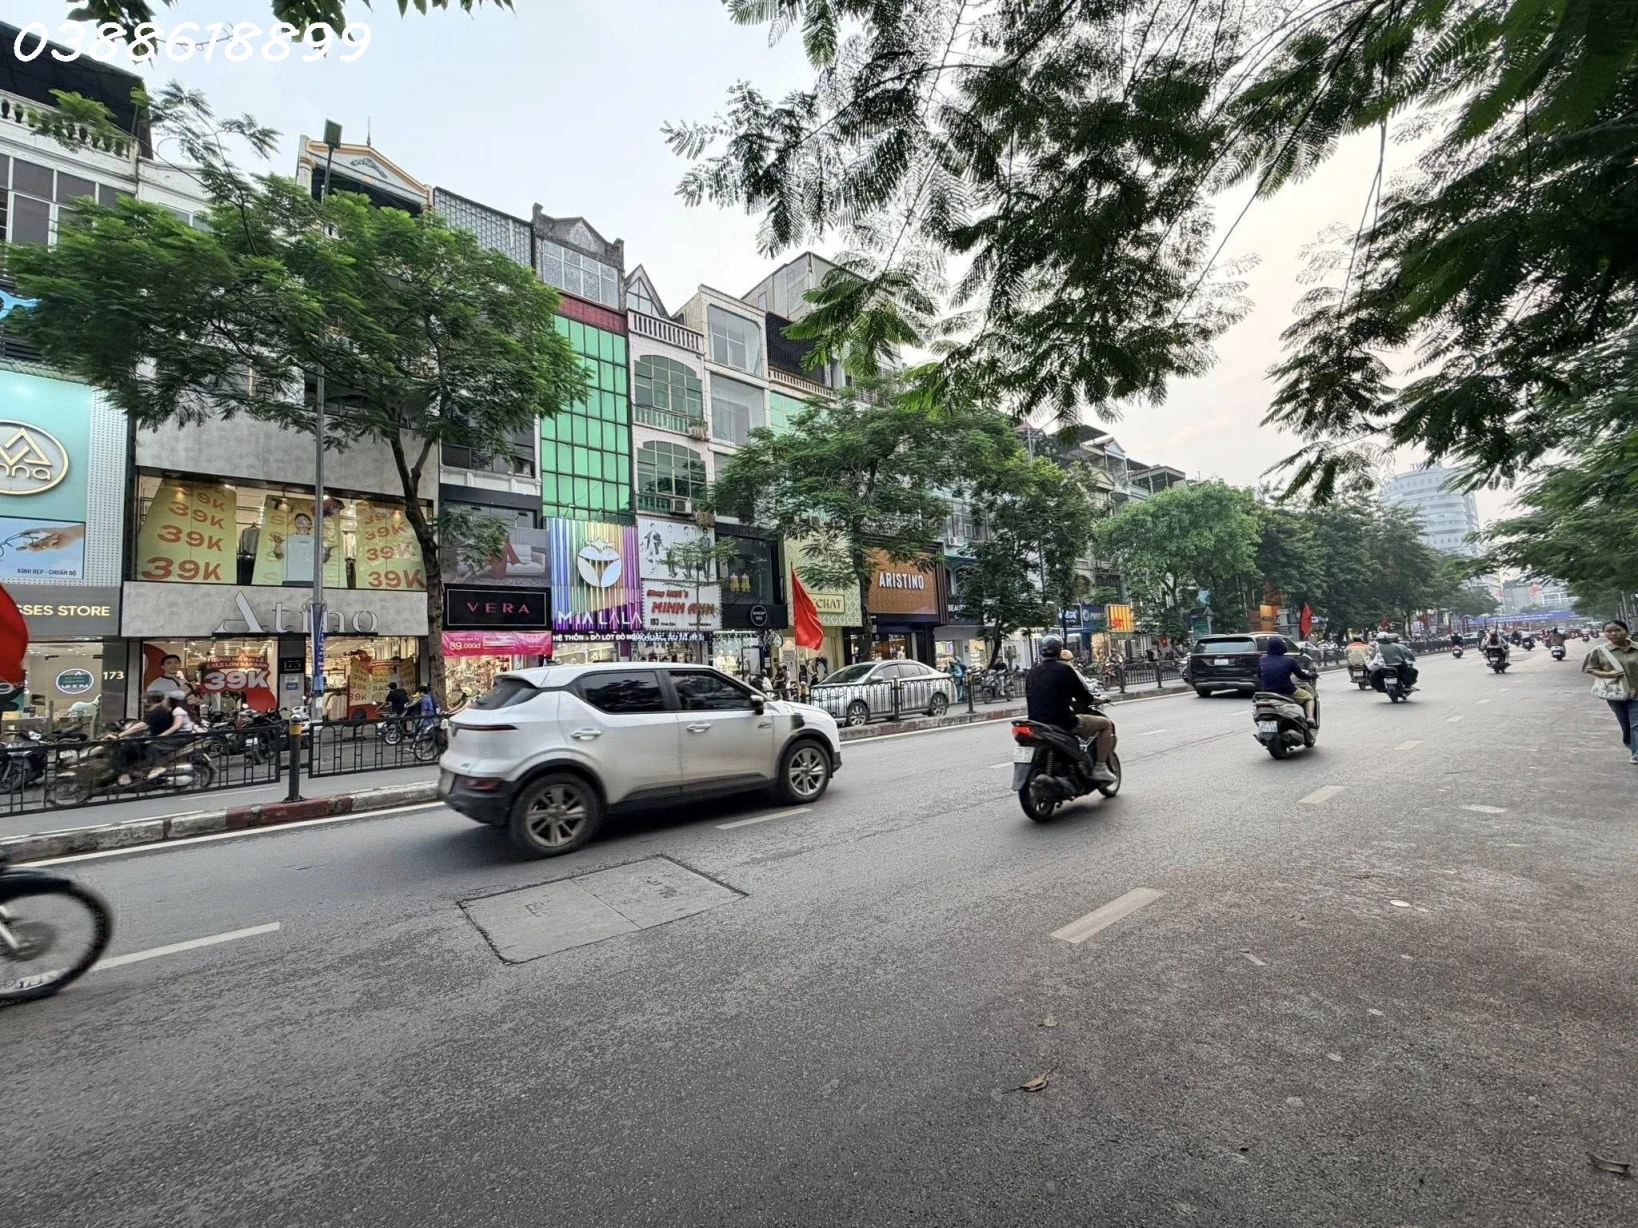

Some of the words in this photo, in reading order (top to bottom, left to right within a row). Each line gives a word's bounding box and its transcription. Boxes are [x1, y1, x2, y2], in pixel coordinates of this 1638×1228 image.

[168, 501, 224, 529] 39K
[157, 524, 224, 552] 39K
[365, 522, 406, 540] 39K
[366, 542, 411, 561] 39K
[141, 556, 222, 581] 39K
[368, 569, 426, 588] 39K
[879, 572, 924, 590] ARISTINO
[58, 605, 110, 616] STORE
[214, 590, 379, 633] Atino
[467, 602, 529, 614] VERA
[651, 602, 686, 614] MINH
[813, 598, 842, 609] CHAT
[103, 671, 124, 680] 173
[204, 671, 269, 690] 39K
